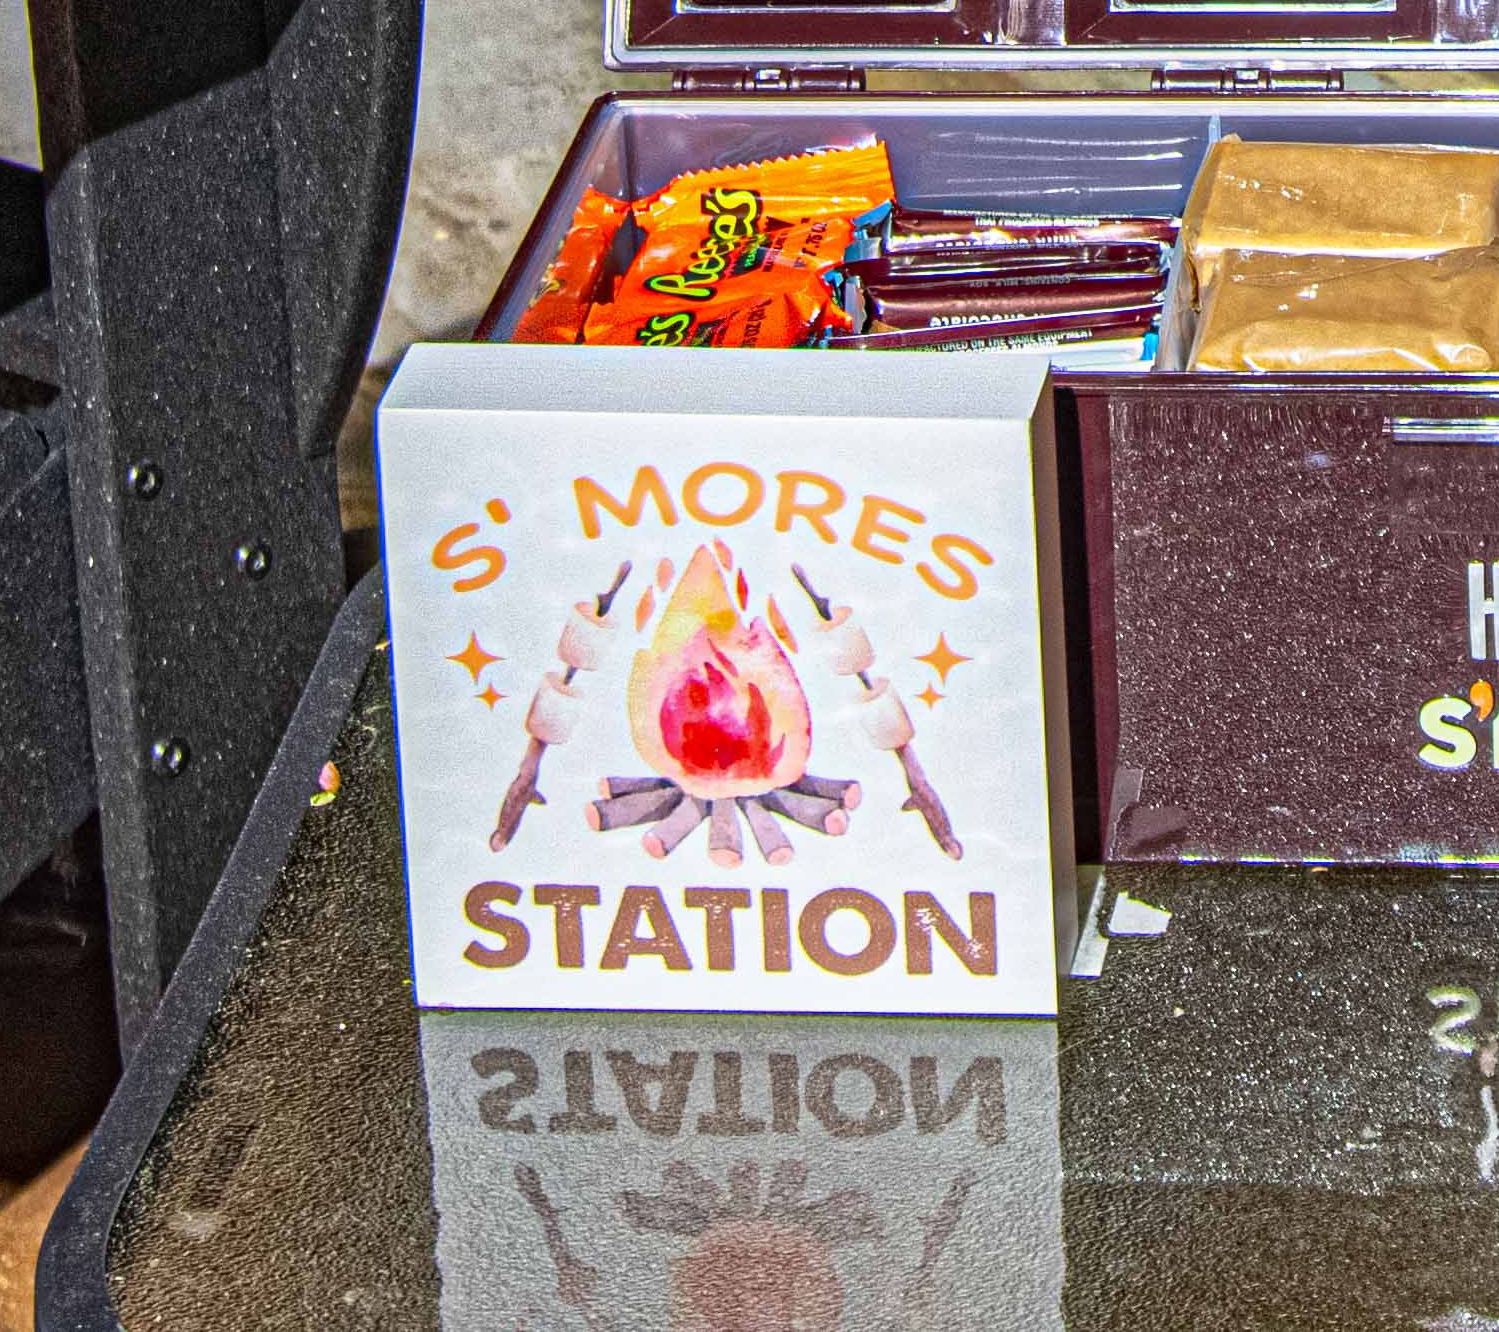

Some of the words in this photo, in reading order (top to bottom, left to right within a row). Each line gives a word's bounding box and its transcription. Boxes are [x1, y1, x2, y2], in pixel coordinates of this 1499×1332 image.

[647, 186, 760, 301] Reese's
[431, 497, 513, 594] S'
[573, 461, 996, 602] MORES
[462, 880, 998, 977] STATION
